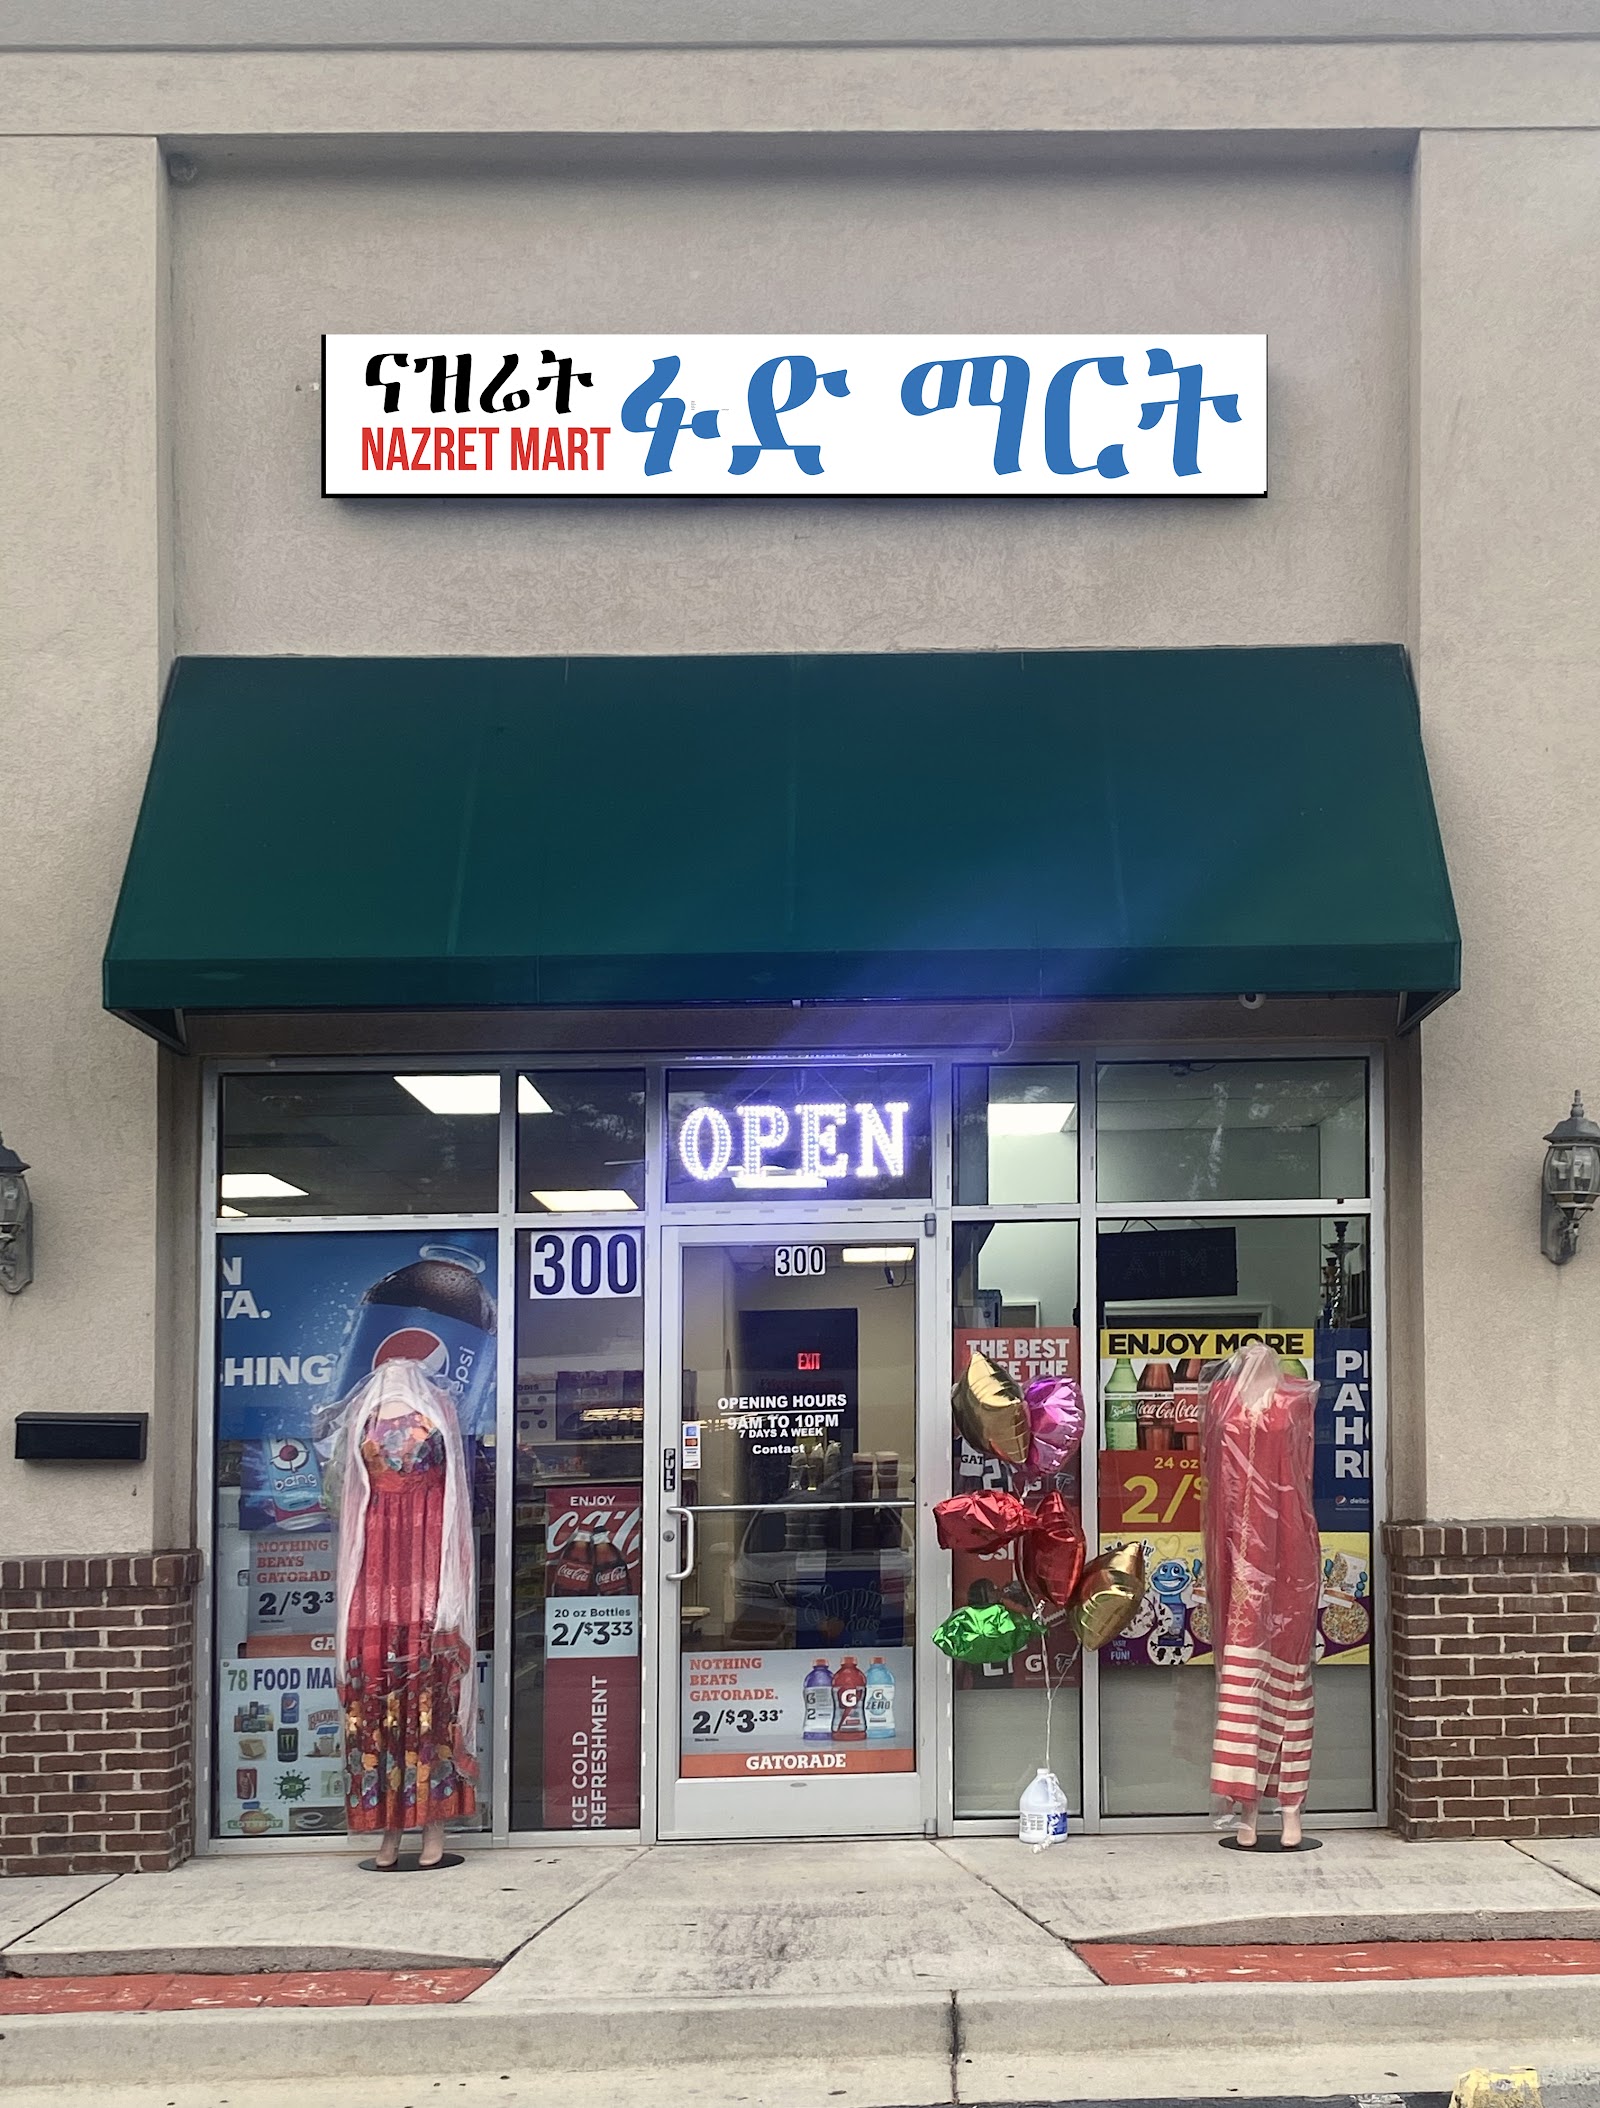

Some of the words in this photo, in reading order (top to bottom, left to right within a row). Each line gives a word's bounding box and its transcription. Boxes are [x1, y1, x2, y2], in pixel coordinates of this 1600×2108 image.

[365, 349, 594, 414] ናዝሬት
[621, 355, 851, 477] ፉድ
[901, 348, 1243, 479] ማርት
[362, 427, 500, 470] NAZRET
[510, 427, 611, 470] MART
[680, 1101, 909, 1180] OPEN
[533, 1233, 637, 1296] 300
[777, 1246, 823, 1275] 300
[966, 1339, 1010, 1358] THE
[1014, 1338, 1070, 1358] BEST
[1108, 1333, 1209, 1355] ENJOY
[797, 1352, 821, 1370] EXIT
[221, 1354, 333, 1387] HING
[717, 1395, 788, 1410] OPENING
[792, 1394, 847, 1408] HOURS
[728, 1416, 763, 1430] 9AM
[767, 1415, 790, 1429] TO
[794, 1414, 839, 1428] 10PM
[739, 1430, 746, 1439] 7
[748, 1429, 777, 1438] DAYS
[780, 1428, 789, 1438] A
[791, 1427, 824, 1437] WEEK
[752, 1443, 805, 1455] Contact
[664, 1449, 675, 1490] PULL
[1154, 1457, 1174, 1469] 24
[1180, 1459, 1199, 1470] oz
[274, 1473, 318, 1491] bang
[570, 1495, 616, 1507] ENJOY
[257, 1540, 329, 1553] NOTHING
[256, 1555, 304, 1568] BEATS
[256, 1570, 334, 1584] GATORAD
[258, 1590, 334, 1616] 2/$3.3
[554, 1608, 570, 1619] 20
[573, 1609, 587, 1618] oz
[590, 1606, 631, 1617] Bottles
[310, 1635, 336, 1651] GA
[690, 1657, 762, 1670] NOTHING
[227, 1669, 248, 1691] 78
[254, 1668, 301, 1690] FOOD
[307, 1667, 337, 1689] MA
[690, 1674, 738, 1686] BEATS
[690, 1688, 779, 1702] GATORADE.
[841, 1688, 857, 1708] G
[865, 1700, 891, 1711] ZERO
[571, 1731, 589, 1789] COLD
[590, 1675, 608, 1829] REFRESHMENT
[746, 1753, 846, 1770] GATORADE
[571, 1796, 588, 1828] ICE
